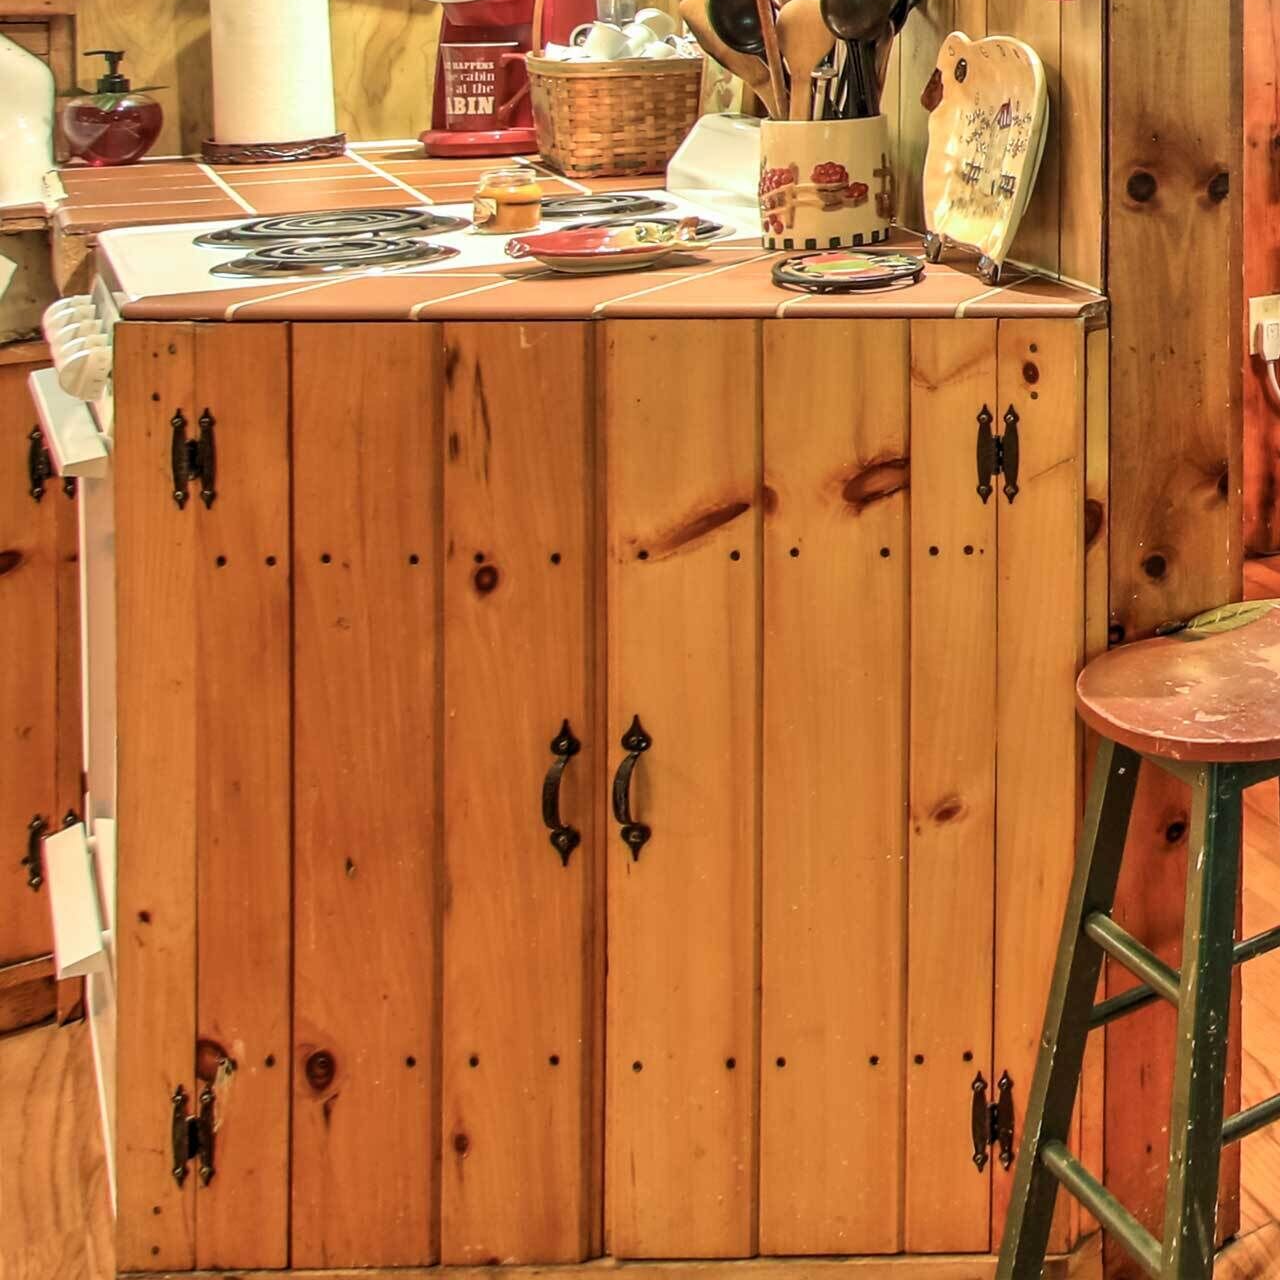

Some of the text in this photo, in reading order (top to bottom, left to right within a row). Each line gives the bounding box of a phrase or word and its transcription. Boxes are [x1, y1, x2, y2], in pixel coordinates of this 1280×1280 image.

[460, 71, 495, 82] cabin
[472, 83, 495, 94] the
[446, 96, 495, 115] ABIN
